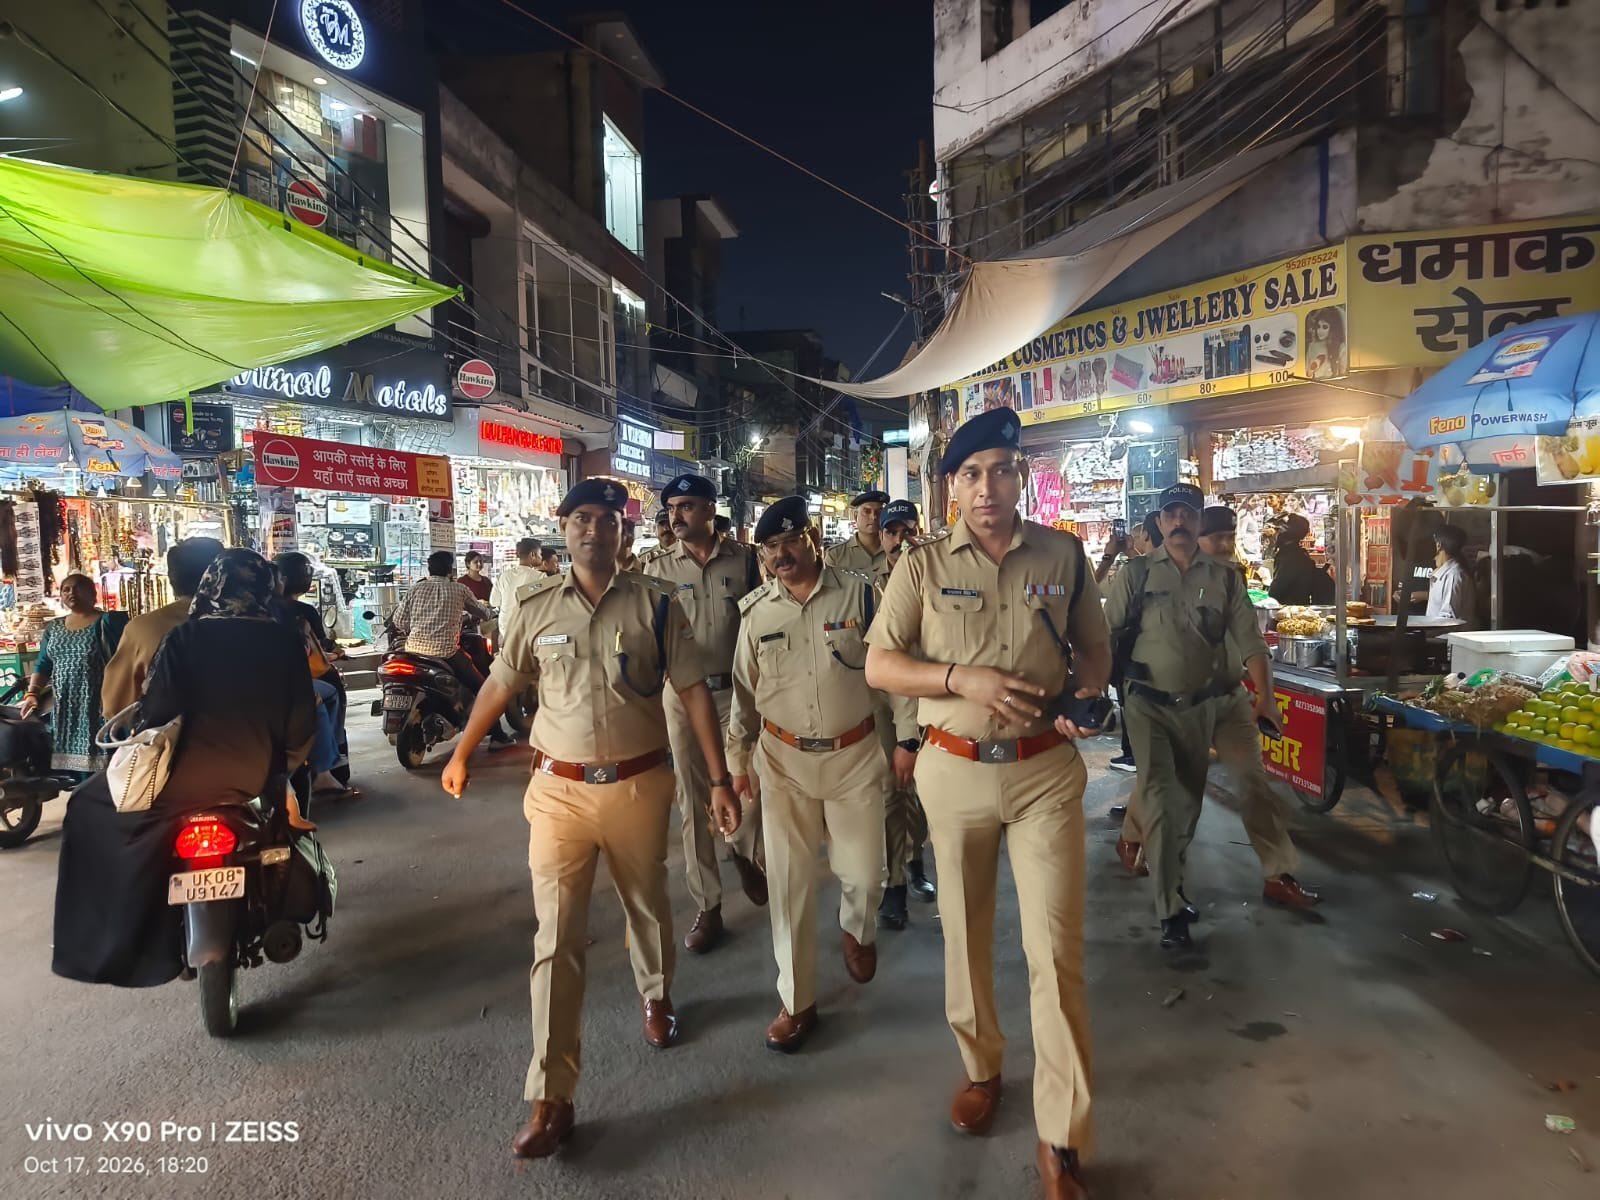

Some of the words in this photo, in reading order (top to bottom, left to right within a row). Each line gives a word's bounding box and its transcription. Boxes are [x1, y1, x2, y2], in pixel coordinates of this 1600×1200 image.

[287, 192, 328, 214] Hawkins
[1285, 250, 1338, 271] 9528755224
[1358, 224, 1600, 285] धमाक
[1011, 320, 1107, 368] COSMETICS
[1112, 315, 1128, 344] &
[1133, 282, 1256, 340] JWELLERY
[1264, 262, 1337, 310] SALE
[458, 372, 495, 387] Hawkins
[1429, 416, 1466, 434] Fena
[1471, 413, 1548, 427] POWERWASH
[263, 454, 299, 468] Hawkins
[313, 449, 348, 465] आपकी
[350, 453, 374, 470] रसोई
[377, 457, 387, 468] के
[389, 457, 406, 473] लिए
[313, 467, 333, 485] यहाँ
[336, 469, 354, 487] पाएँ
[356, 473, 381, 488] सबसे
[384, 478, 408, 490] अच्छा
[1168, 487, 1192, 495] POLICE
[888, 505, 909, 514] POLICE
[1052, 523, 1077, 532] SALE
[193, 870, 235, 886] UK08
[186, 883, 239, 900] U9147
